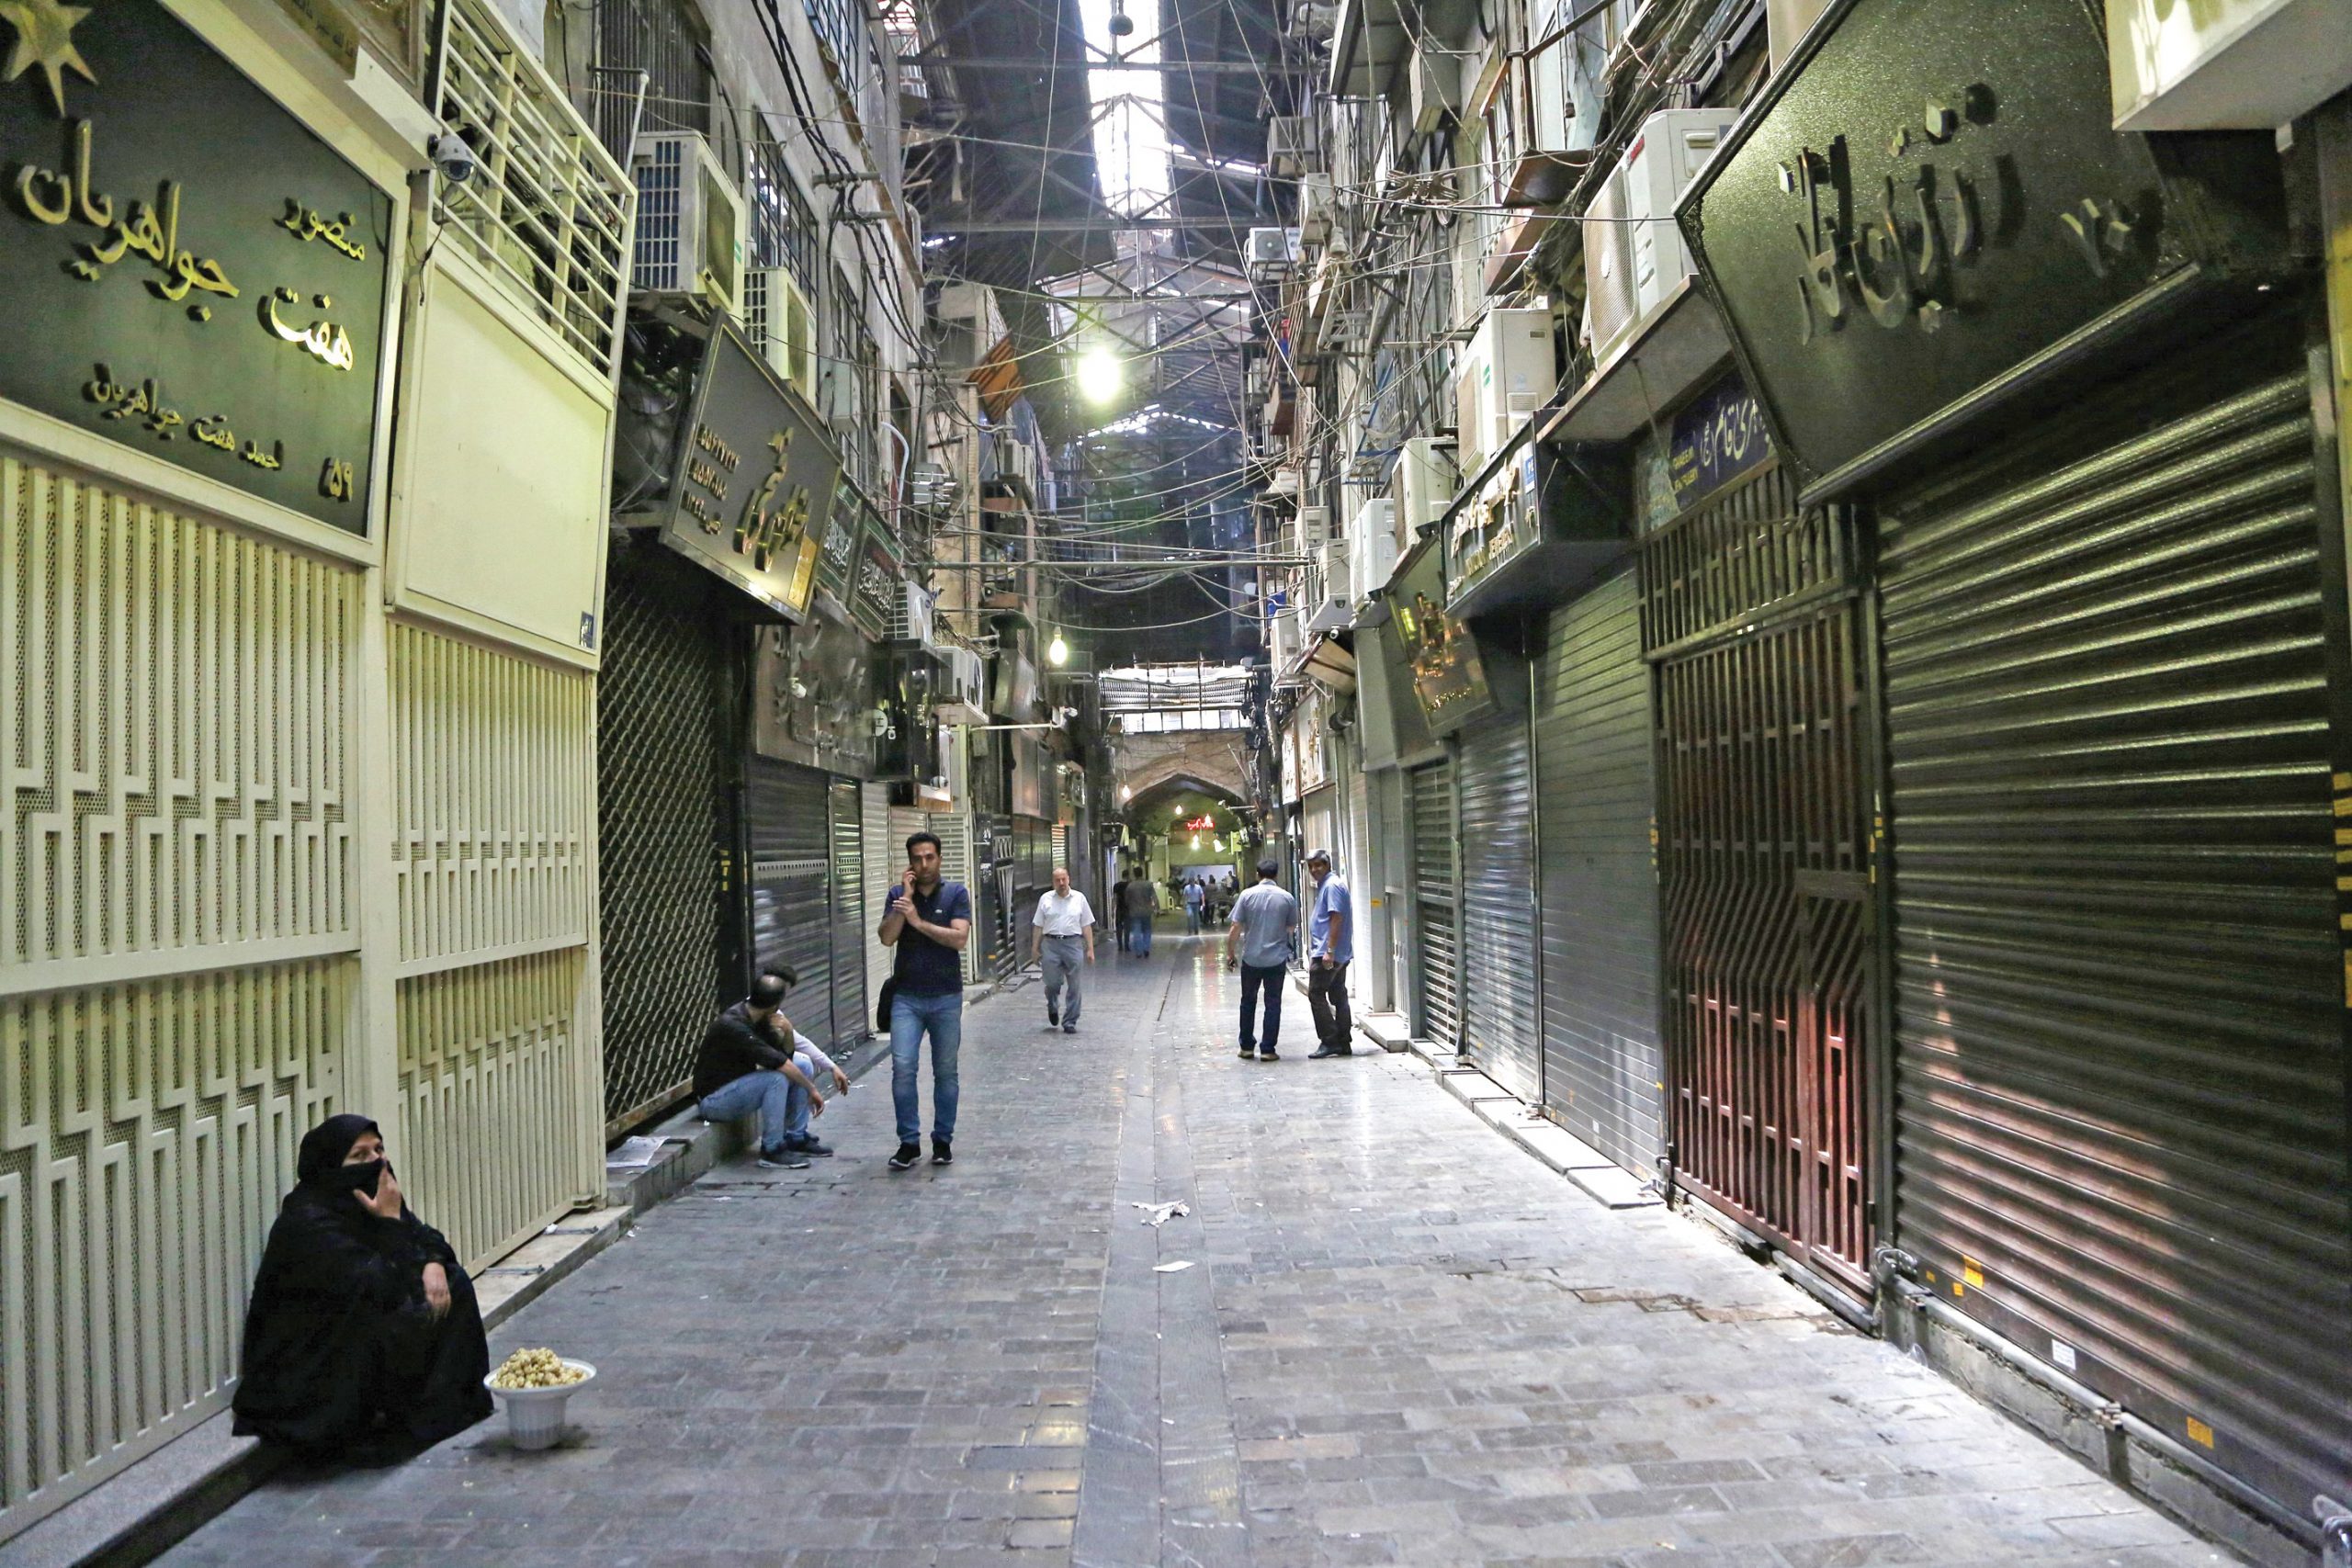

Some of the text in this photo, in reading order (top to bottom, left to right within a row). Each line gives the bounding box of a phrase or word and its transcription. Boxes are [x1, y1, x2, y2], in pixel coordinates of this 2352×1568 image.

[18, 120, 353, 371] هفت جواهریان
[285, 200, 365, 261] منصور
[90, 364, 184, 440] جواهریان
[196, 414, 236, 450] هفت
[327, 459, 354, 502] ۵۹
